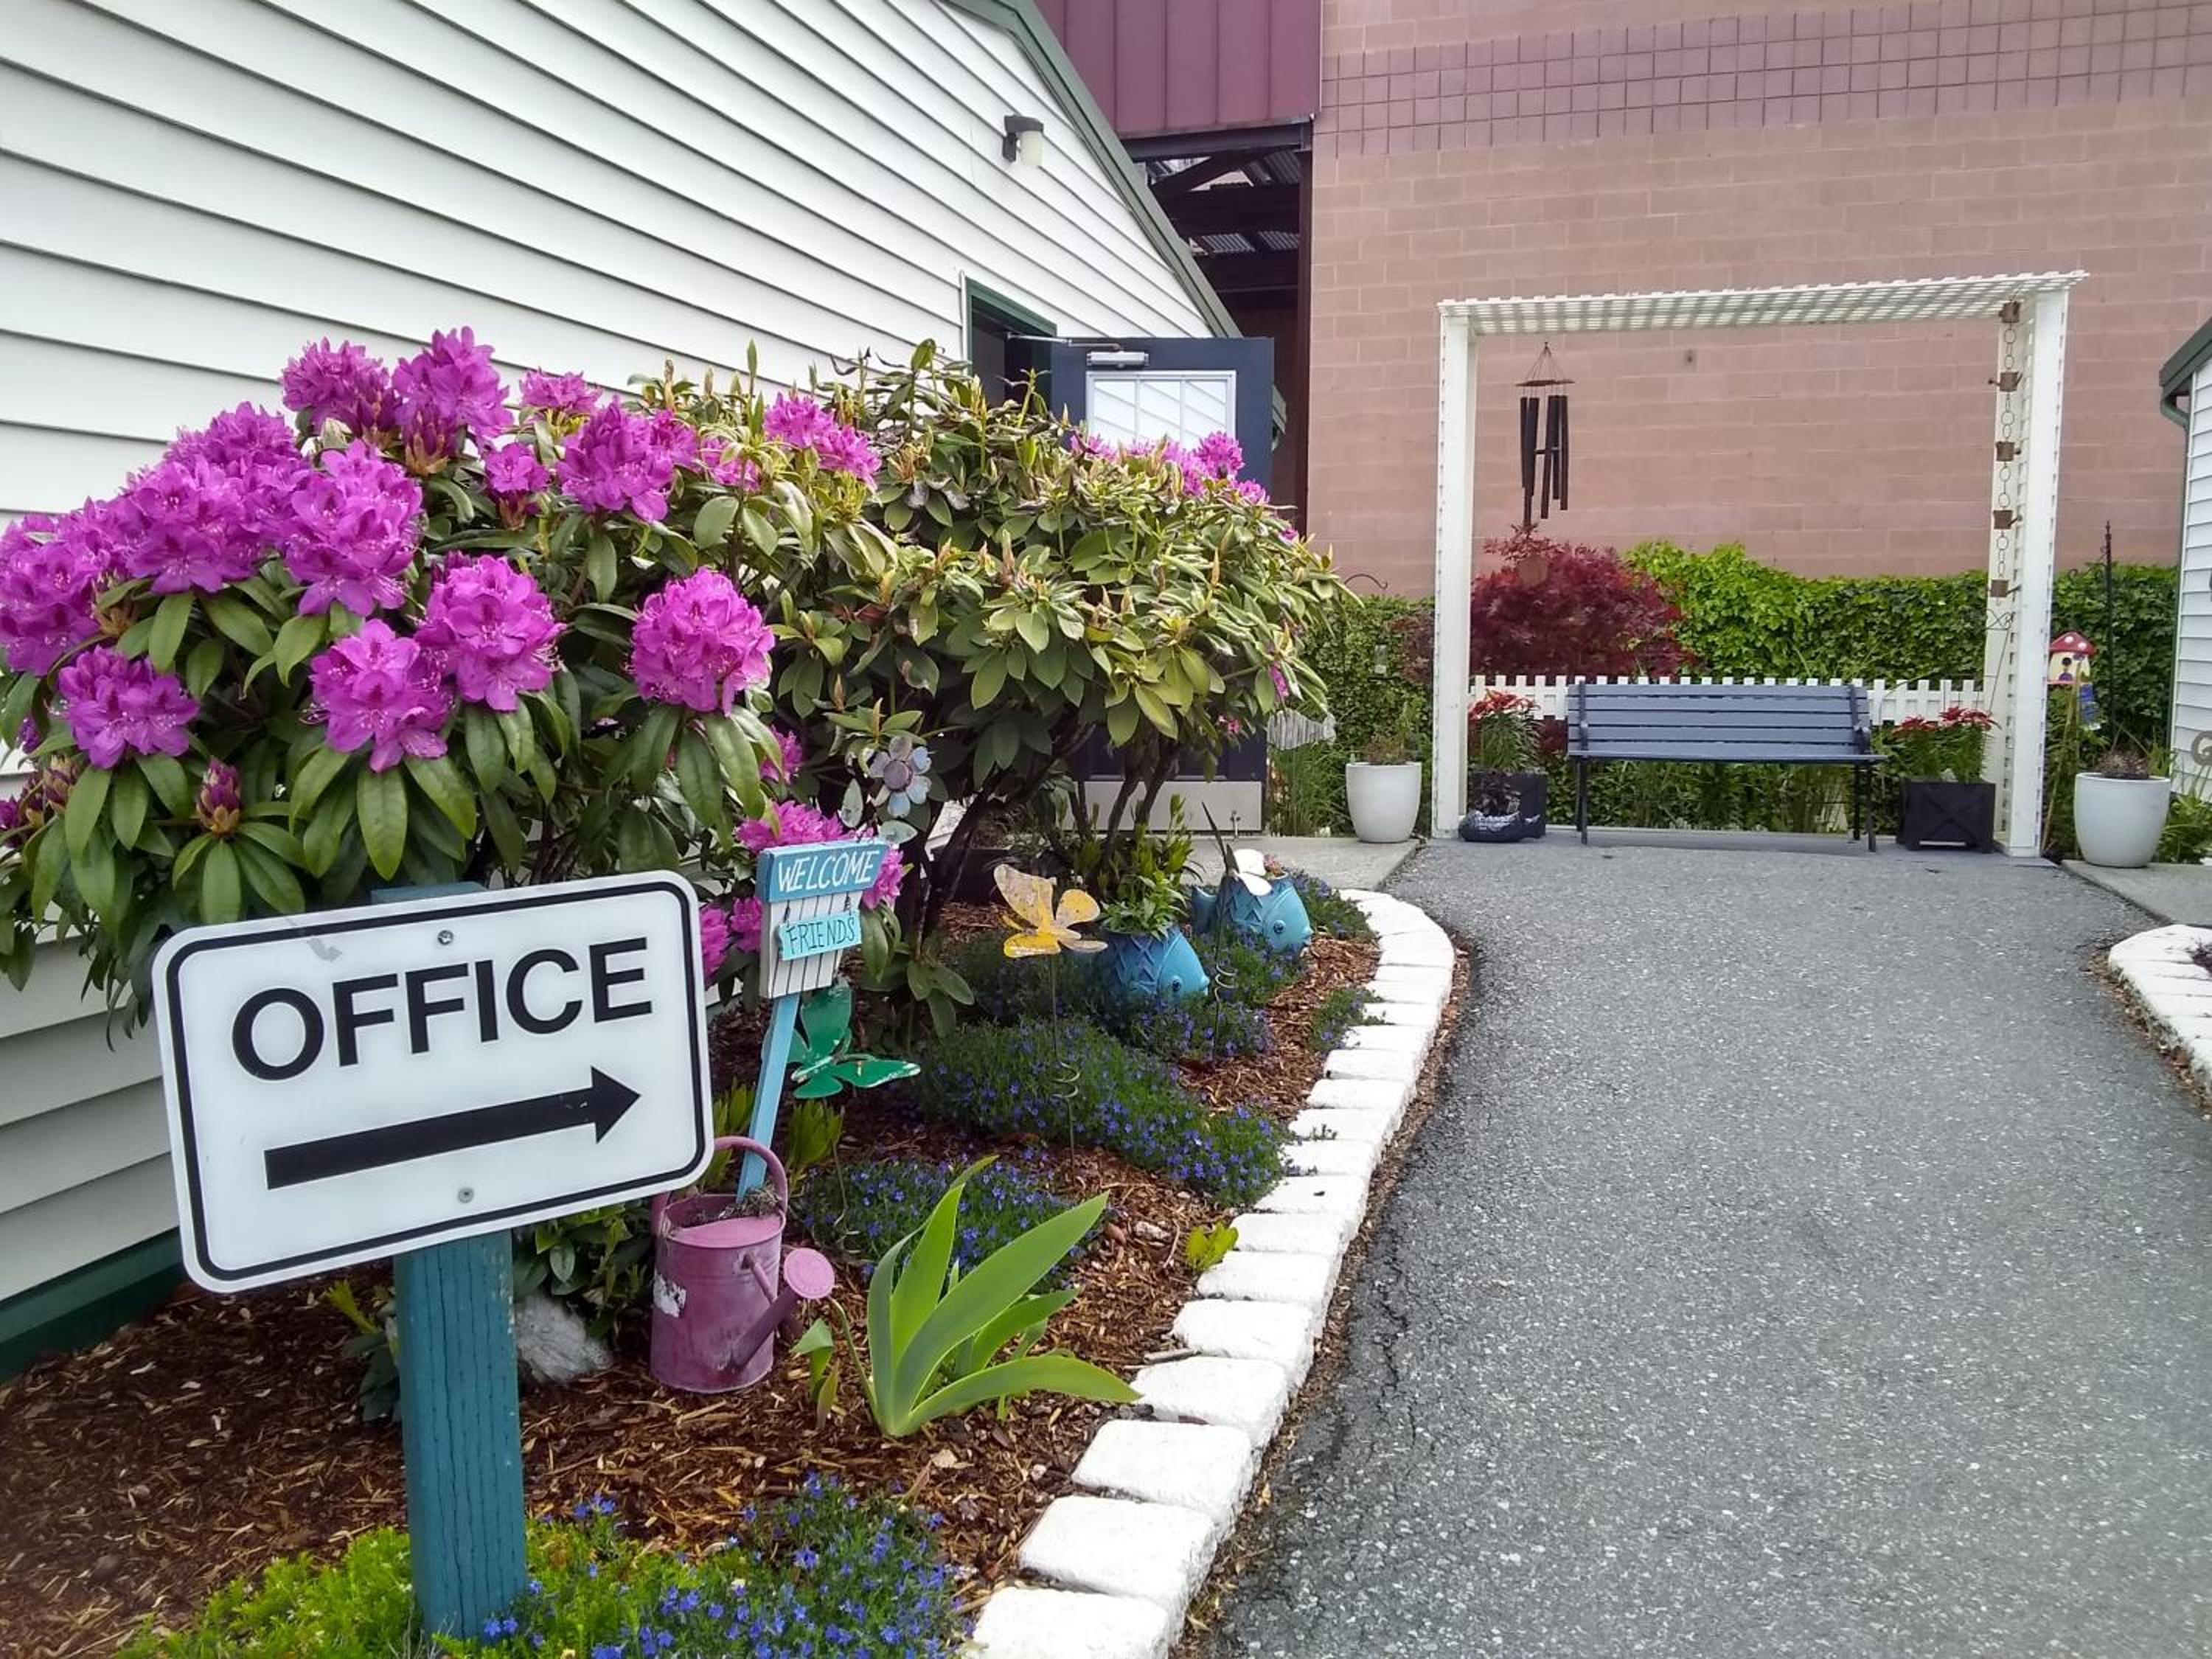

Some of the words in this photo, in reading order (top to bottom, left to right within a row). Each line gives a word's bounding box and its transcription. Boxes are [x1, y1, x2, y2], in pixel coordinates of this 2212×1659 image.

[778, 850, 880, 891] WELCOME
[786, 917, 855, 954] FRIENDS
[232, 937, 653, 1080] OFFICE
